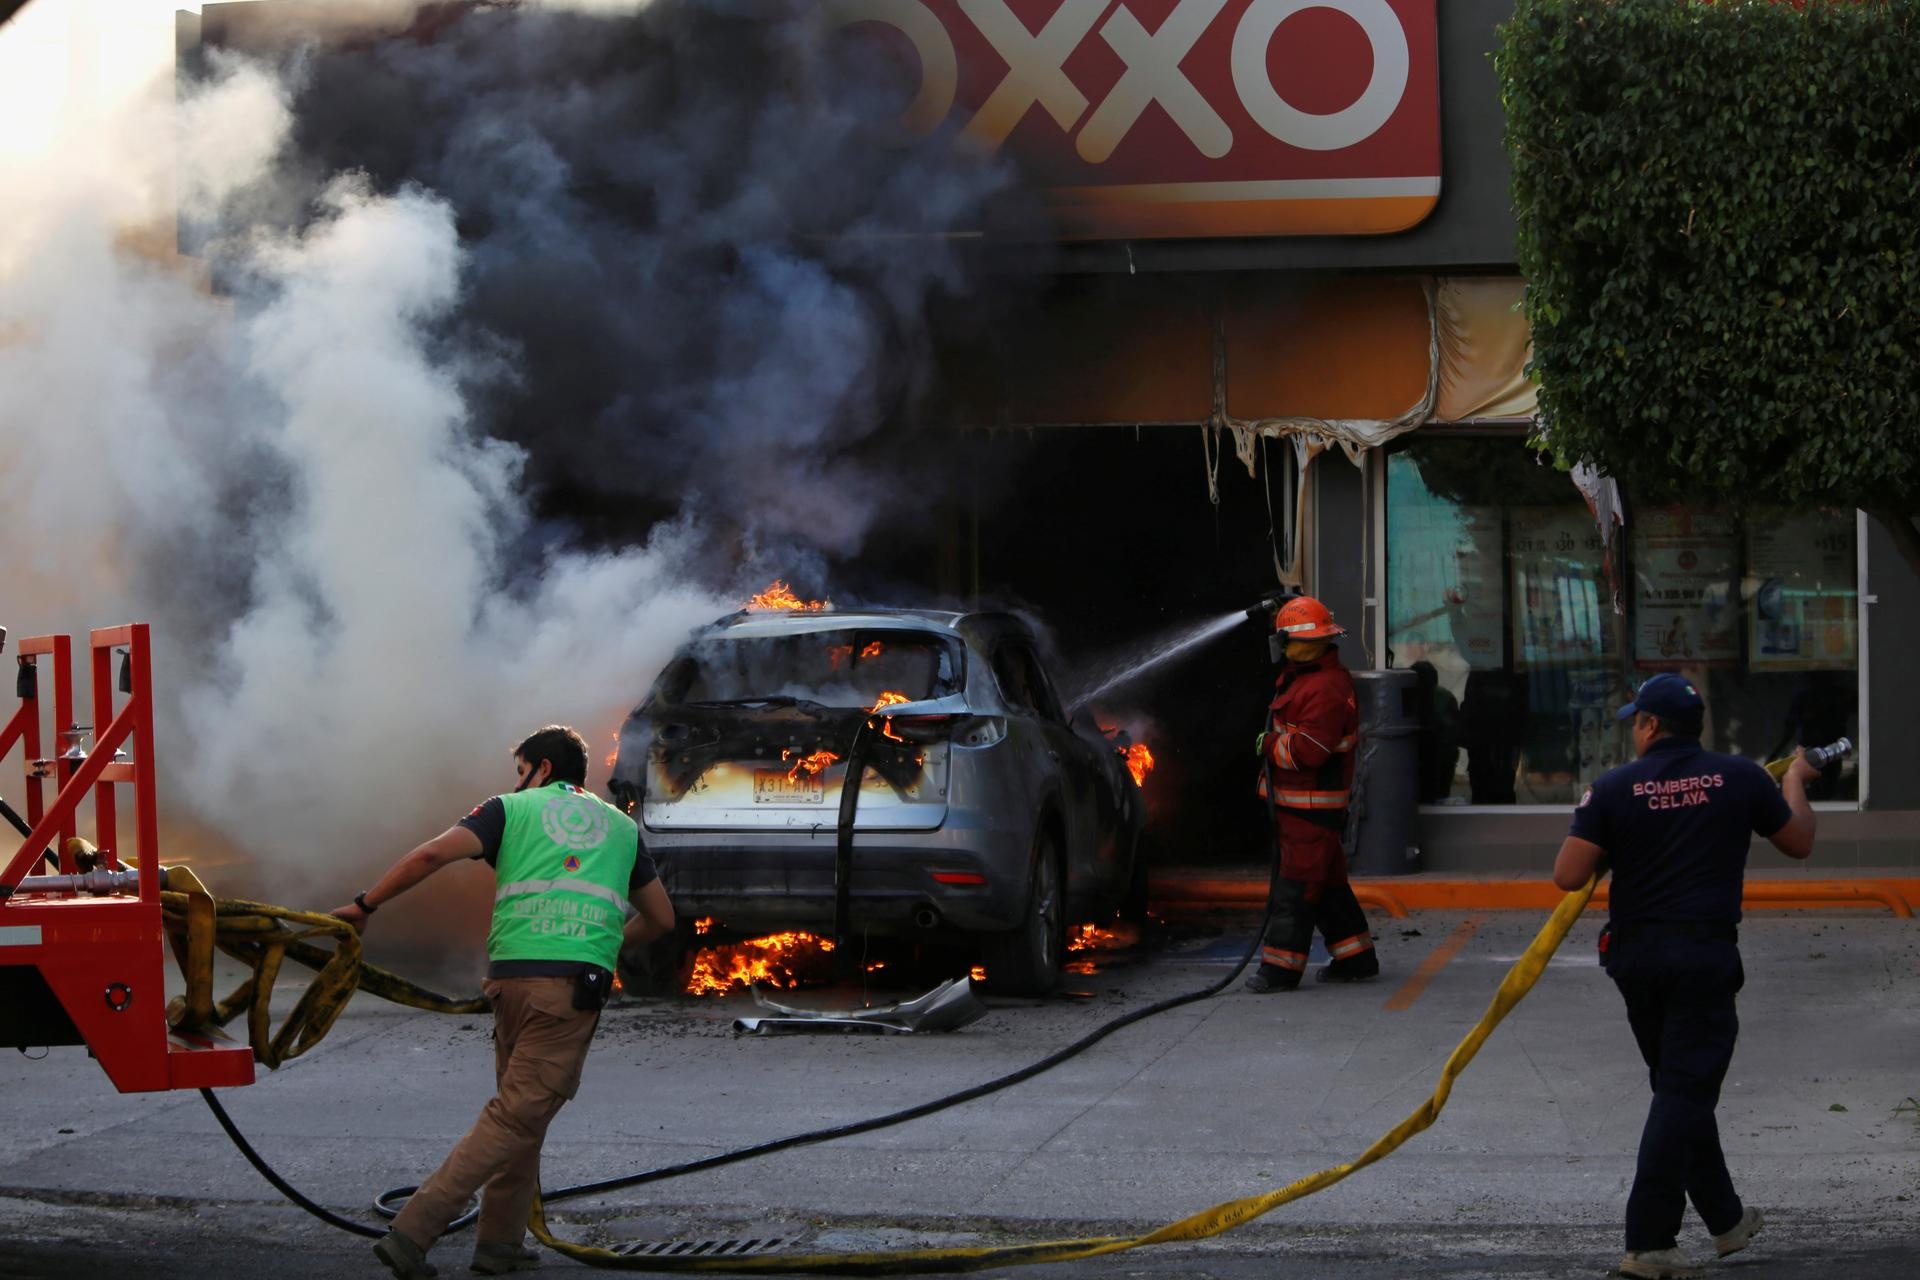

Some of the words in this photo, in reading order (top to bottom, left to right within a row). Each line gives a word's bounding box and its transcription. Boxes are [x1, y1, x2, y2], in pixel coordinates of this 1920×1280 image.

[1632, 774, 1724, 796] BOMBEROS
[1648, 790, 1709, 810] CELAYA
[531, 919, 587, 937] CELAYA
